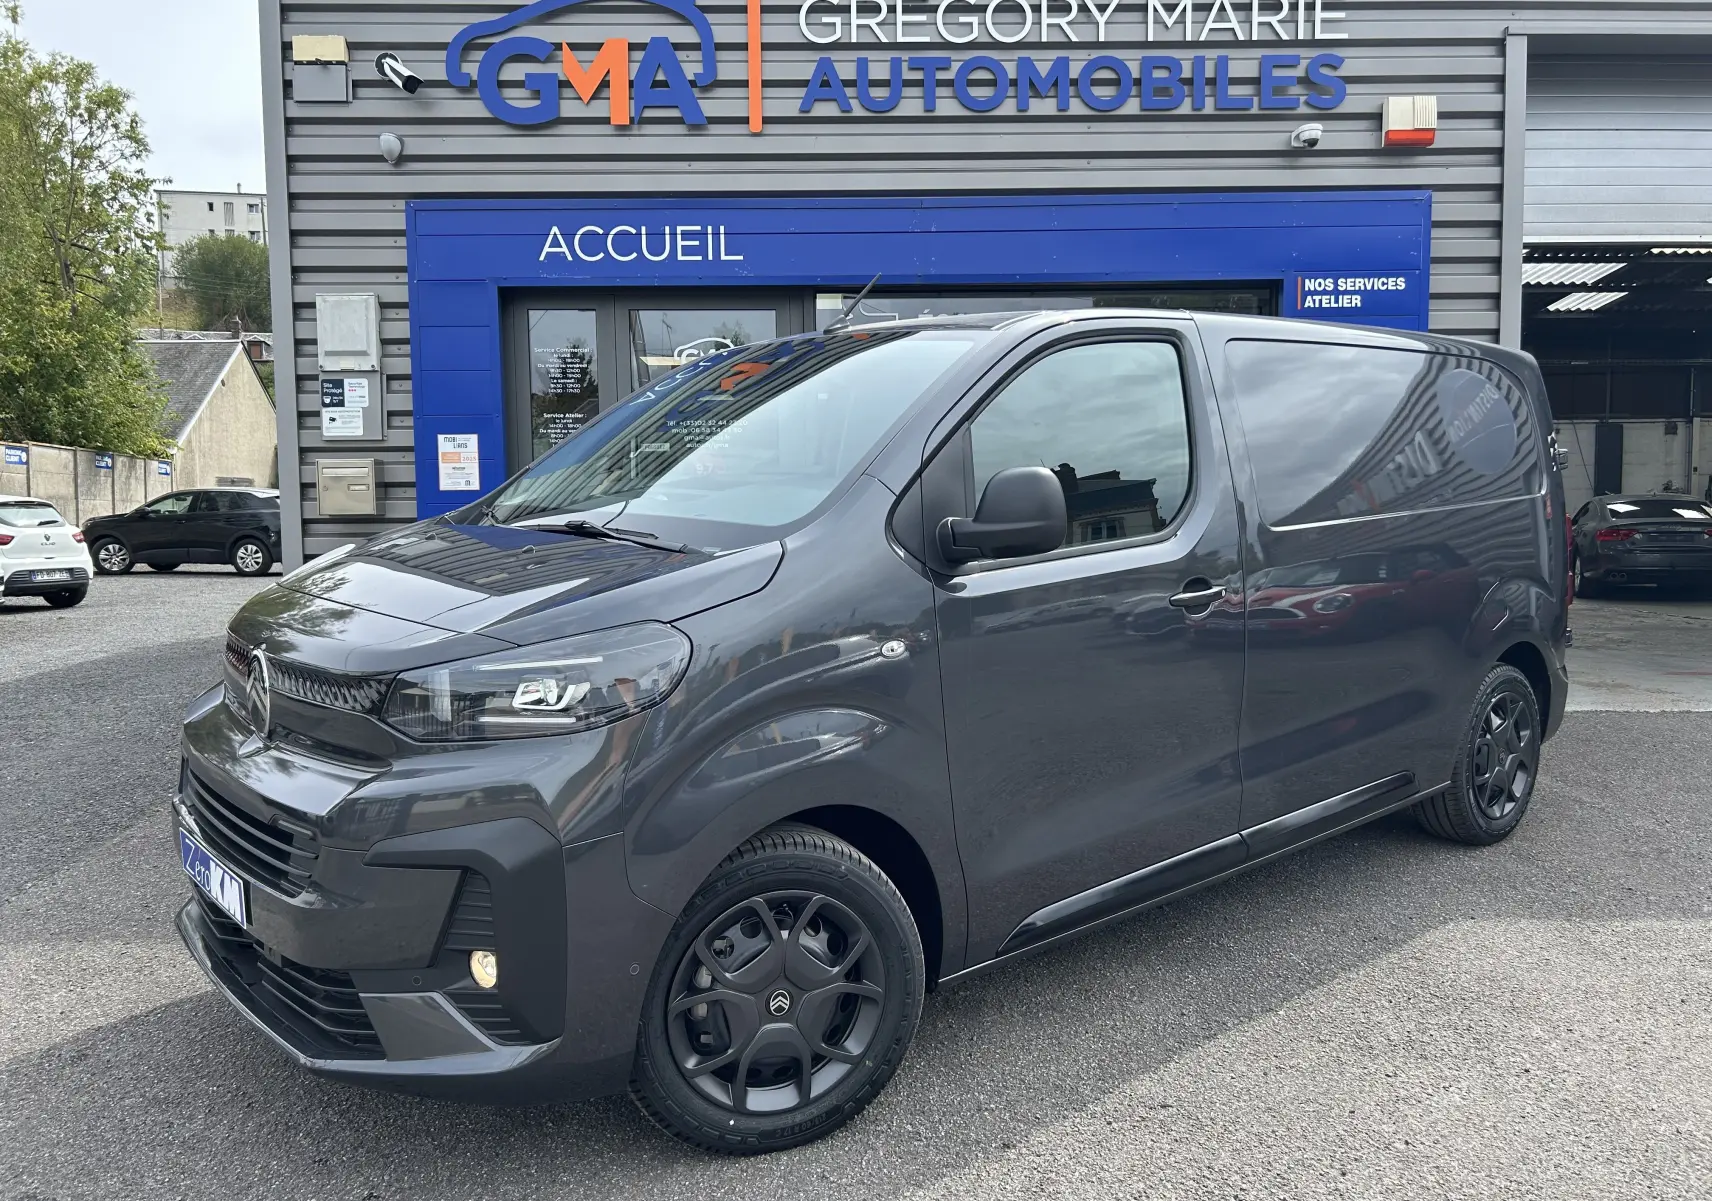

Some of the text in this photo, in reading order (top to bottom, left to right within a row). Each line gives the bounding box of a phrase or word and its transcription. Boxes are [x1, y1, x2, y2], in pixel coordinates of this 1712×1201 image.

[799, 0, 1349, 44] GREGORY MARIE
[477, 36, 709, 125] GMA
[799, 53, 1347, 111] AUTOMOBILES
[539, 225, 744, 261] ACCUEIL
[1304, 277, 1406, 291] NOS SERVICES
[1304, 295, 1361, 308] ATELIER
